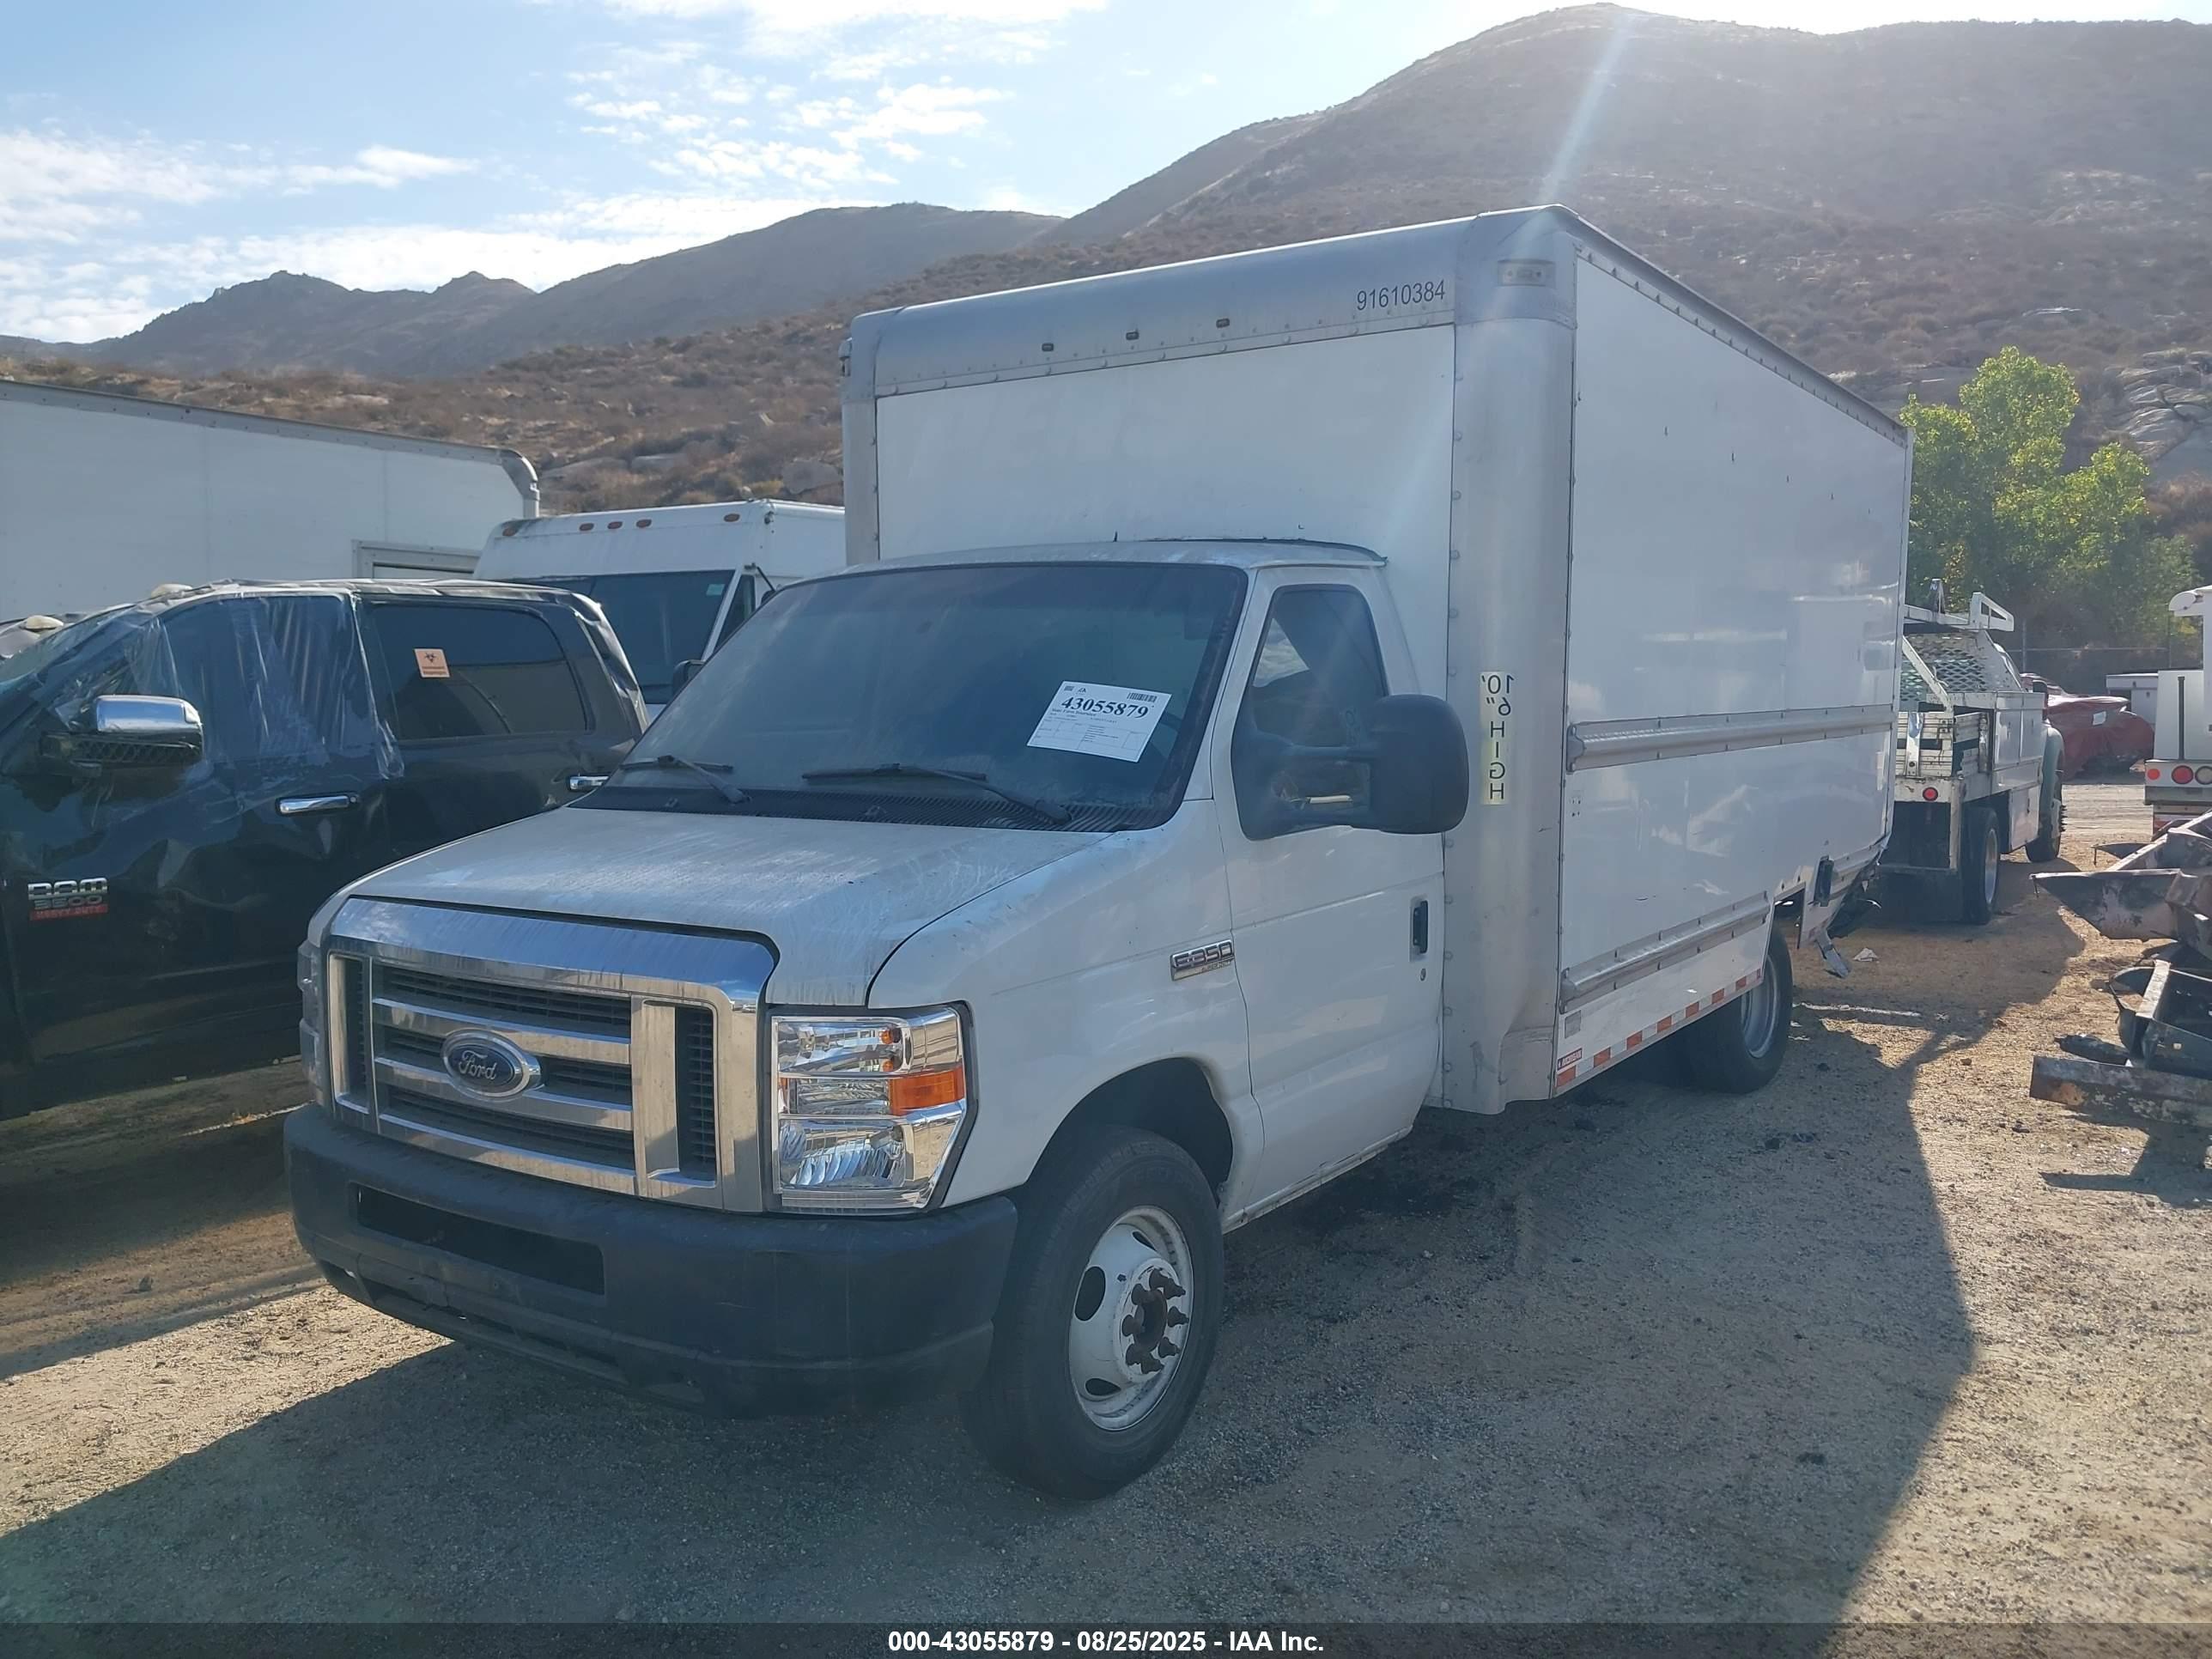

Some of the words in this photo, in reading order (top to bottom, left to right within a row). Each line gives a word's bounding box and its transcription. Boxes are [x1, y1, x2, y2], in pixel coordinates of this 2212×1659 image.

[1356, 279, 1446, 312] 91610384
[1060, 696, 1149, 719] 43055879
[27, 878, 107, 900] RAM
[459, 1049, 497, 1080] Ford
